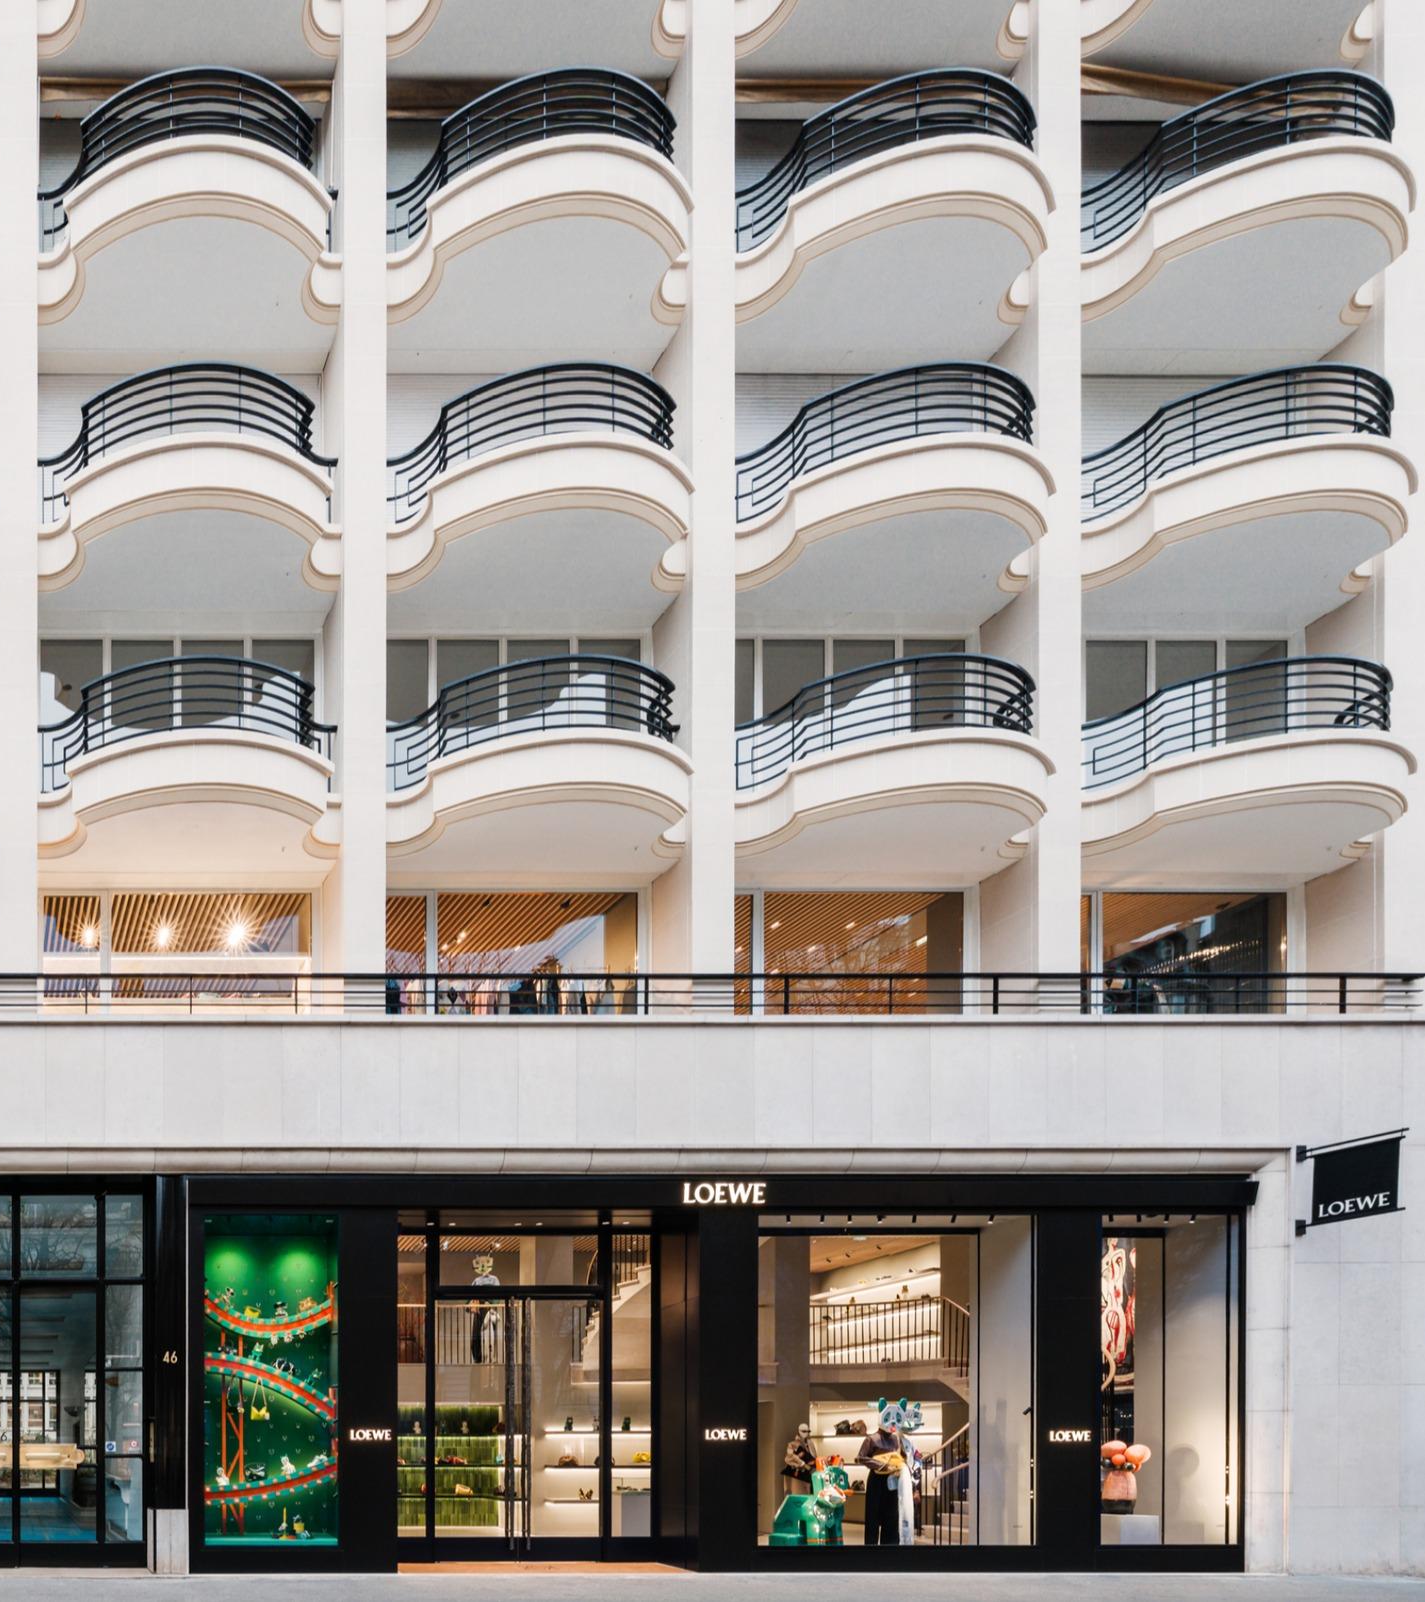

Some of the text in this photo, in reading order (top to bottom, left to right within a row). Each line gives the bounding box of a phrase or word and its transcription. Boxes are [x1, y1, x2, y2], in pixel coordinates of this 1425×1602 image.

[682, 1181, 767, 1205] LOEWE
[1318, 1191, 1391, 1218] LOEWE
[162, 1351, 178, 1364] 46
[349, 1428, 392, 1441] LOEWE
[704, 1428, 748, 1441] LOEWE
[1049, 1429, 1092, 1442] LOEWE
